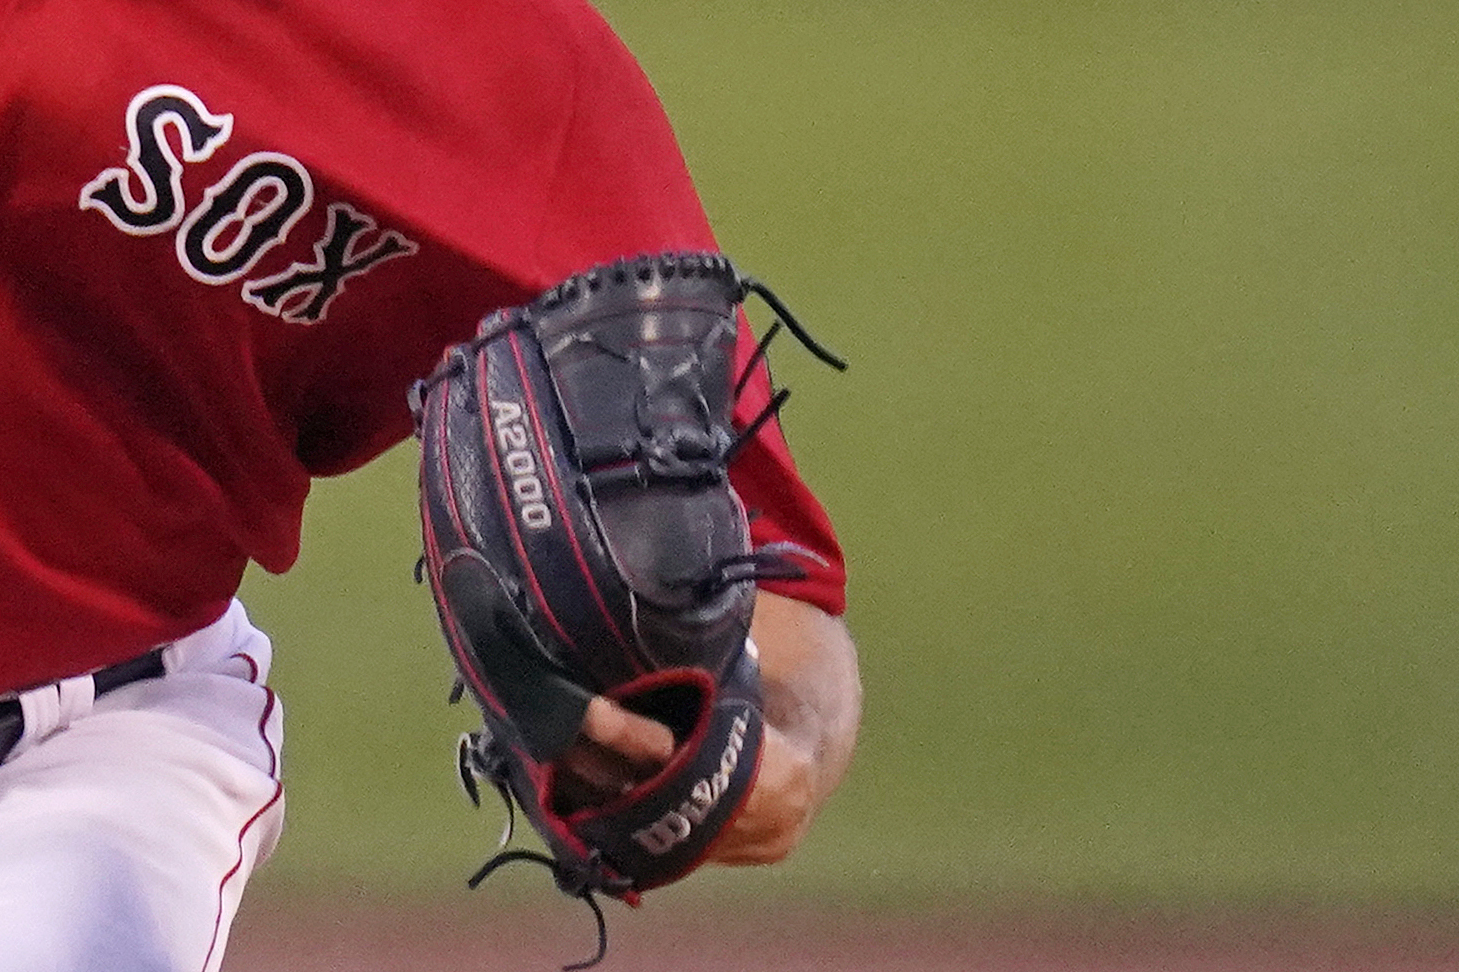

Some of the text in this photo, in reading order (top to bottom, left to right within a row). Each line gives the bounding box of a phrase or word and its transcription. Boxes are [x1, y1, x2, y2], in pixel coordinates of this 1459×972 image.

[79, 84, 420, 325] SOX
[491, 400, 552, 530] A2000
[632, 708, 751, 855] Wilson
